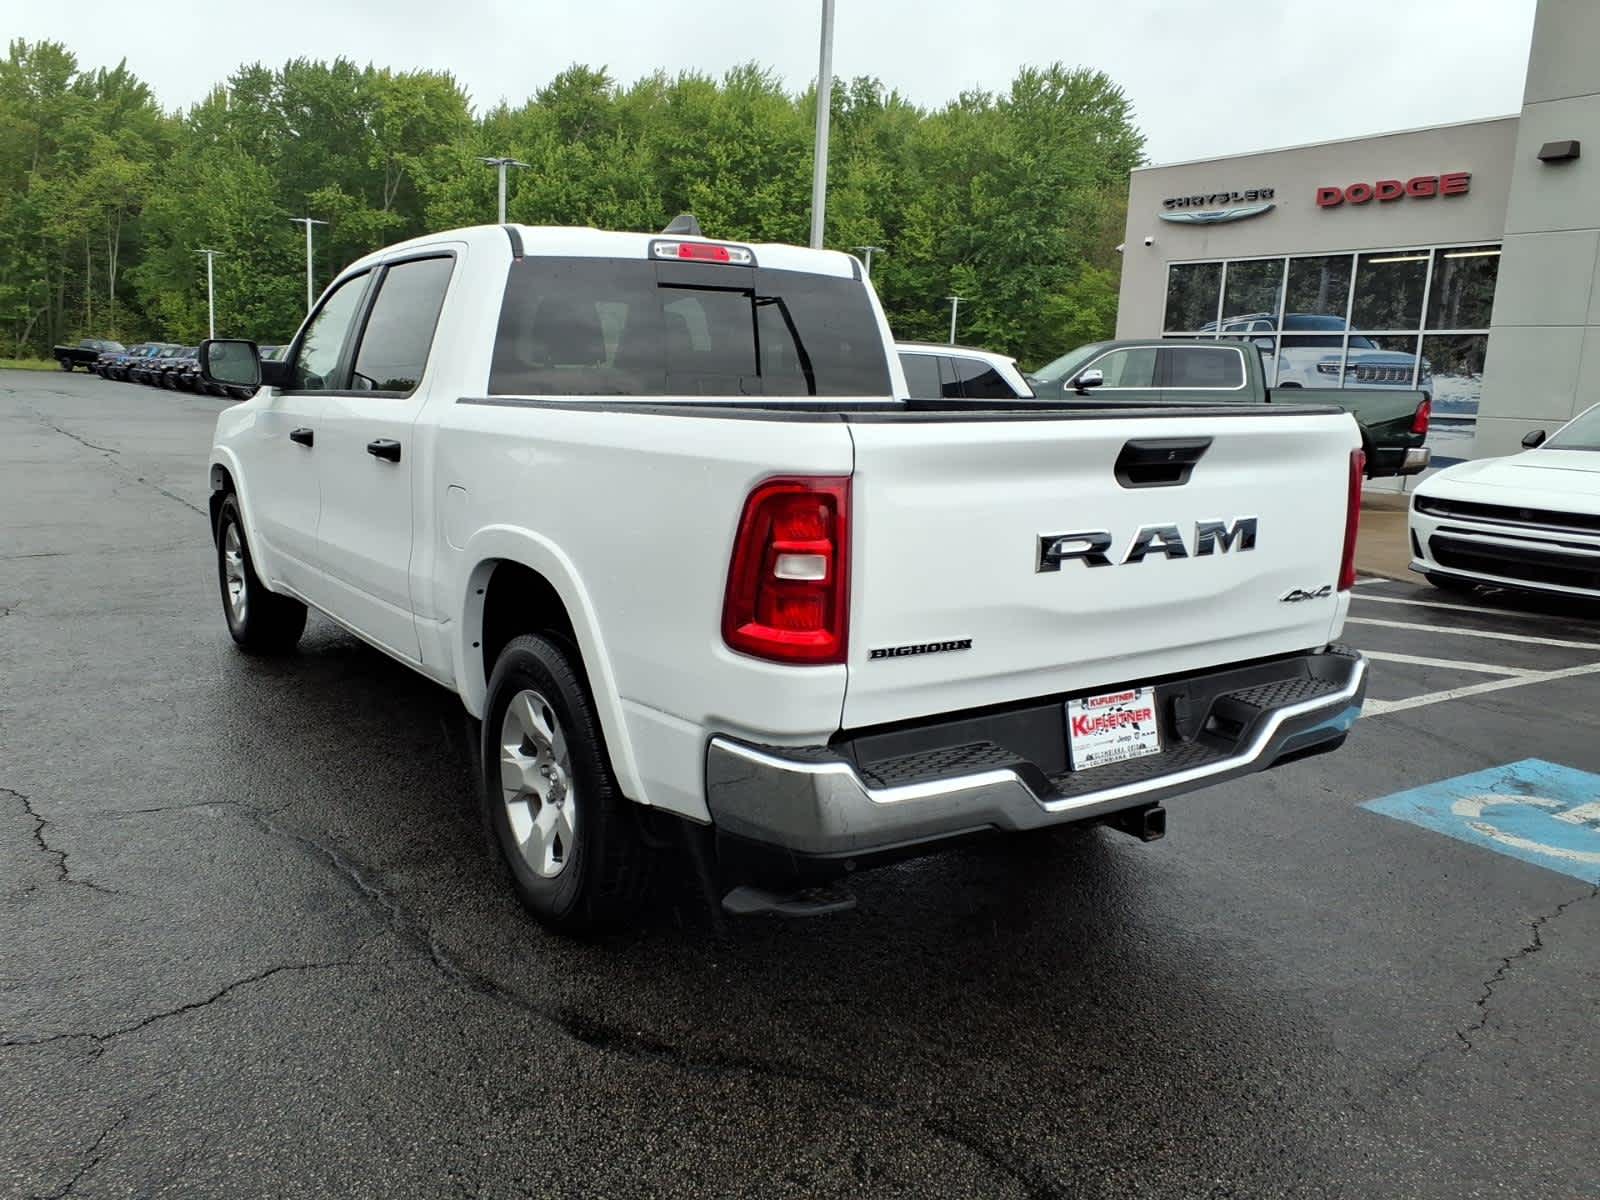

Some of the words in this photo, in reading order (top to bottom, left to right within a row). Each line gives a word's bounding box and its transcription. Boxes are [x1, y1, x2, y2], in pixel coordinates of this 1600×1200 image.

[1163, 188, 1275, 209] CHRYSLER
[1317, 172, 1472, 207] DODGE
[1035, 514, 1258, 574] RAM
[868, 639, 973, 660] BIGHORN
[1089, 692, 1134, 707] KUFLEITNER
